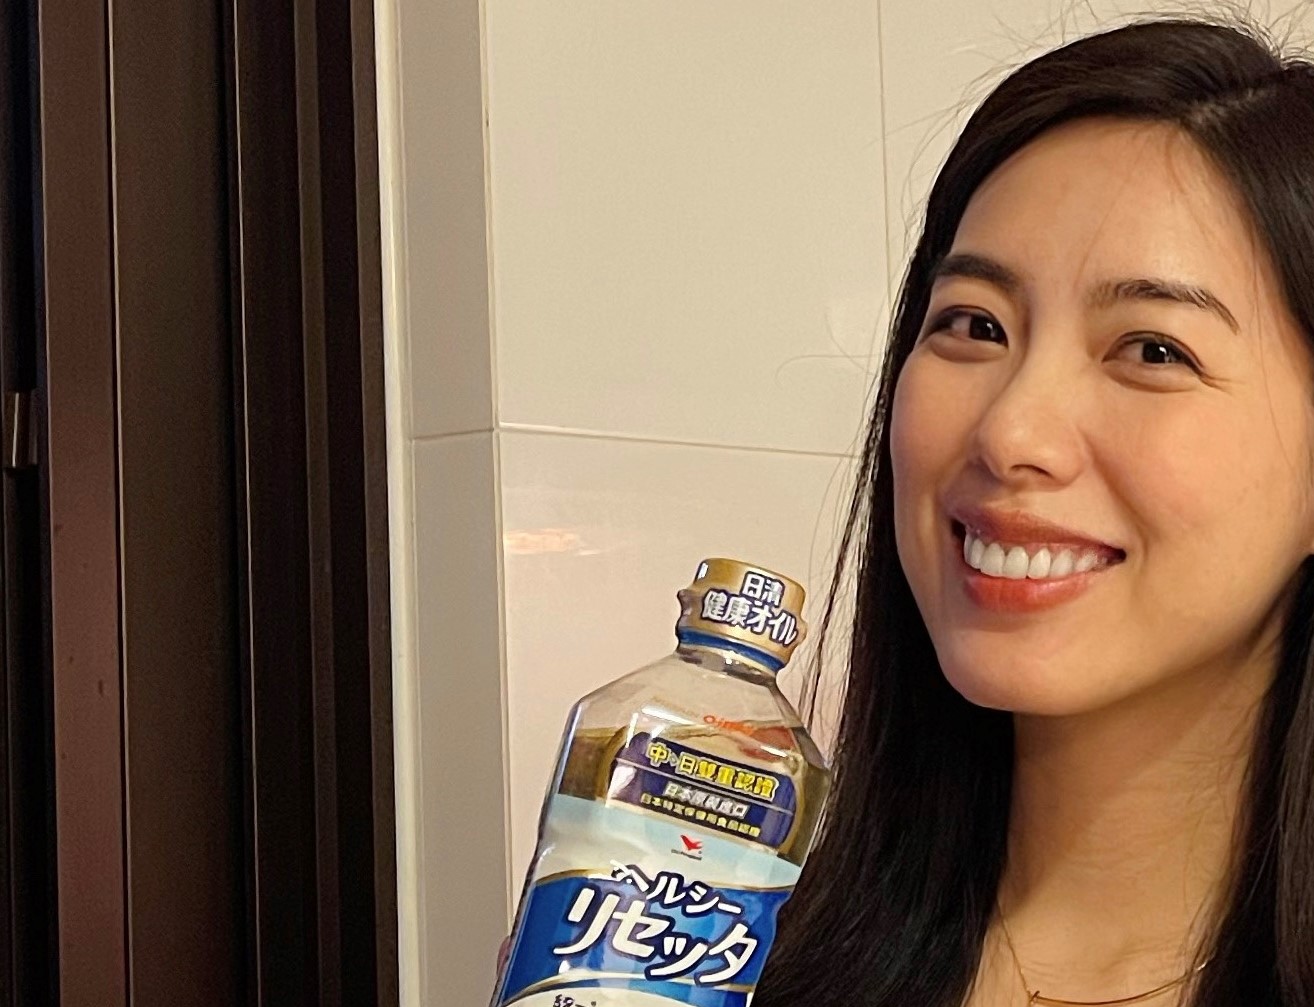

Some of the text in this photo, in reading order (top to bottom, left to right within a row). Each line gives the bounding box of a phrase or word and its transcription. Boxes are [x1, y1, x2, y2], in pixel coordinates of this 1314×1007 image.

[702, 590, 798, 645] 健康オイル
[611, 861, 742, 914] ヘルシー
[553, 887, 758, 984] リセッタ
